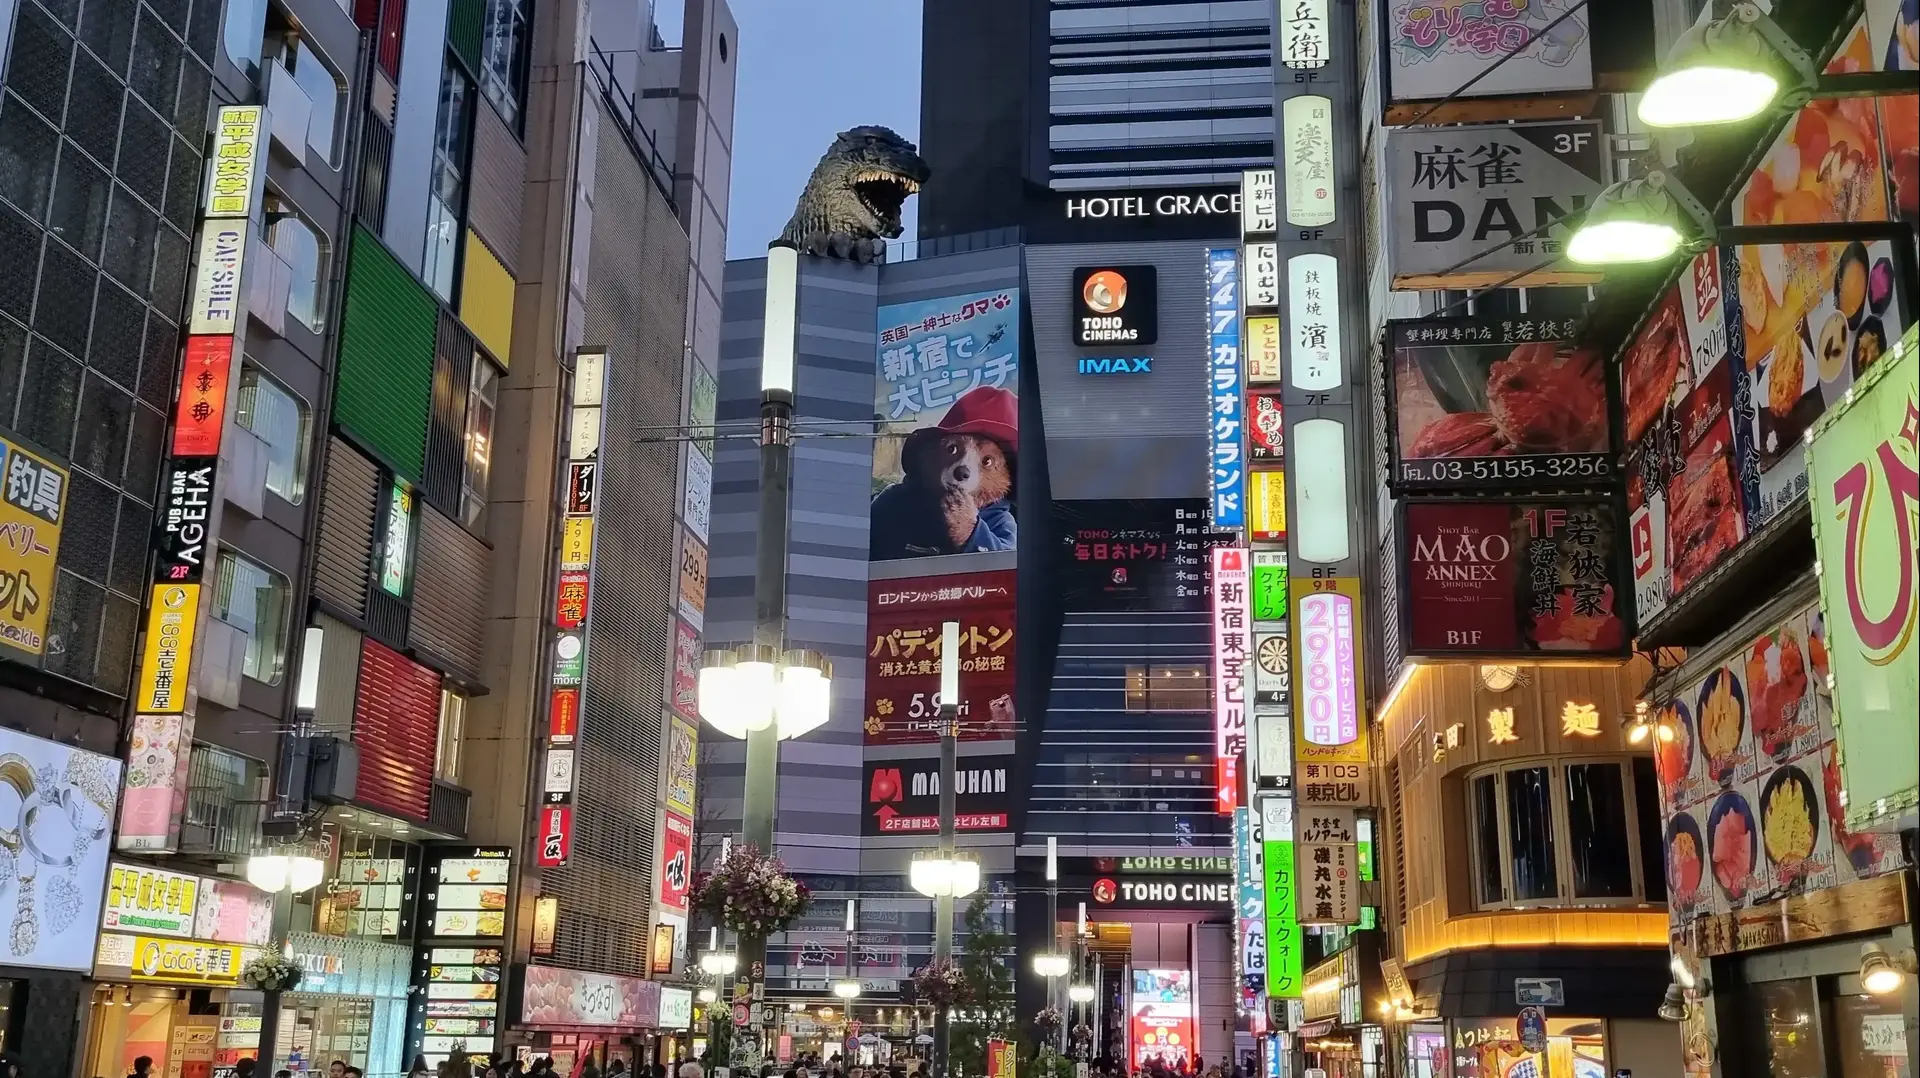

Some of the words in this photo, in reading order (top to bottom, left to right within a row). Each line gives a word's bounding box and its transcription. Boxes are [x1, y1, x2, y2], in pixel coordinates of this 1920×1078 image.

[1295, 72, 1318, 83] 5F
[222, 110, 257, 125] 新宿
[1553, 132, 1592, 154] 3F
[212, 125, 253, 212] 平成女学園
[1411, 142, 1524, 190] 麻雀
[1066, 197, 1150, 218] HOTEL
[1156, 193, 1241, 215] GRACE
[1254, 173, 1275, 229] 川新ビル
[1412, 195, 1587, 243] DAN
[1300, 230, 1324, 241] 6F
[1513, 241, 1562, 256] 新宿
[207, 231, 239, 320] CAPSULE
[1257, 246, 1275, 304] にいむら
[1305, 270, 1321, 316] 鉄板焼
[881, 298, 989, 345] 英国一紳士なクマ
[1082, 317, 1122, 329] TOHO
[1082, 329, 1138, 341] CINEMAS
[1406, 326, 1493, 343] 蟹料理専門店
[882, 335, 974, 381] 新宿で
[1078, 358, 1152, 374] IMAX
[889, 353, 1017, 419] 大ピンチ
[1211, 260, 1241, 517] 747カラオケランド
[1305, 395, 1330, 406] 7F
[1258, 397, 1283, 445] おすすめ
[1255, 447, 1266, 456] 7F
[9, 454, 62, 521] 釣具
[172, 470, 187, 495] BAR
[579, 465, 594, 503] ダーツ
[172, 496, 183, 506] &
[578, 504, 589, 512] 8F
[167, 505, 182, 532] PUB
[178, 467, 211, 564] AGEHA
[1523, 509, 1567, 538] 1F
[571, 518, 583, 561] 299円
[1412, 534, 1510, 562] MAO
[170, 566, 190, 578] 2F
[1312, 568, 1337, 578] 8F
[1425, 564, 1497, 581] ANNEX
[1530, 539, 1562, 618] 海鮮丼
[878, 586, 1008, 604] ロンドンから故郷ペルーへ
[1261, 572, 1274, 618] クォーク
[1313, 580, 1337, 591] 9階
[1441, 581, 1482, 589] SHINJUKU
[559, 583, 586, 621] 麻雀
[1446, 630, 1482, 645] B1F
[151, 623, 180, 709] CoCo壱番屋
[879, 655, 1006, 677] 消えた黄金の秘密
[1220, 582, 1246, 756] 新宿東宝ビル店
[553, 676, 581, 685] more
[1271, 691, 1286, 702] 4F
[912, 768, 1006, 796] MAUHAN
[1276, 777, 1288, 787] 3F
[1306, 764, 1360, 778] 第103
[551, 793, 563, 801] 3F
[1306, 783, 1360, 802] 東京ビル
[885, 815, 1000, 829] 2F店舗出入はビル左側
[1303, 829, 1352, 842] ルノアール
[123, 870, 196, 916] 平成女学園
[1122, 884, 1177, 901] TOHO
[1313, 847, 1333, 919] 磯丸水産
[428, 893, 436, 901] 10
[427, 920, 433, 928] 9
[1274, 870, 1292, 991] カワノ・クォーク
[162, 947, 231, 974] CoCo壱番屋
[418, 1005, 424, 1013] 5
[415, 1040, 420, 1048] 3
